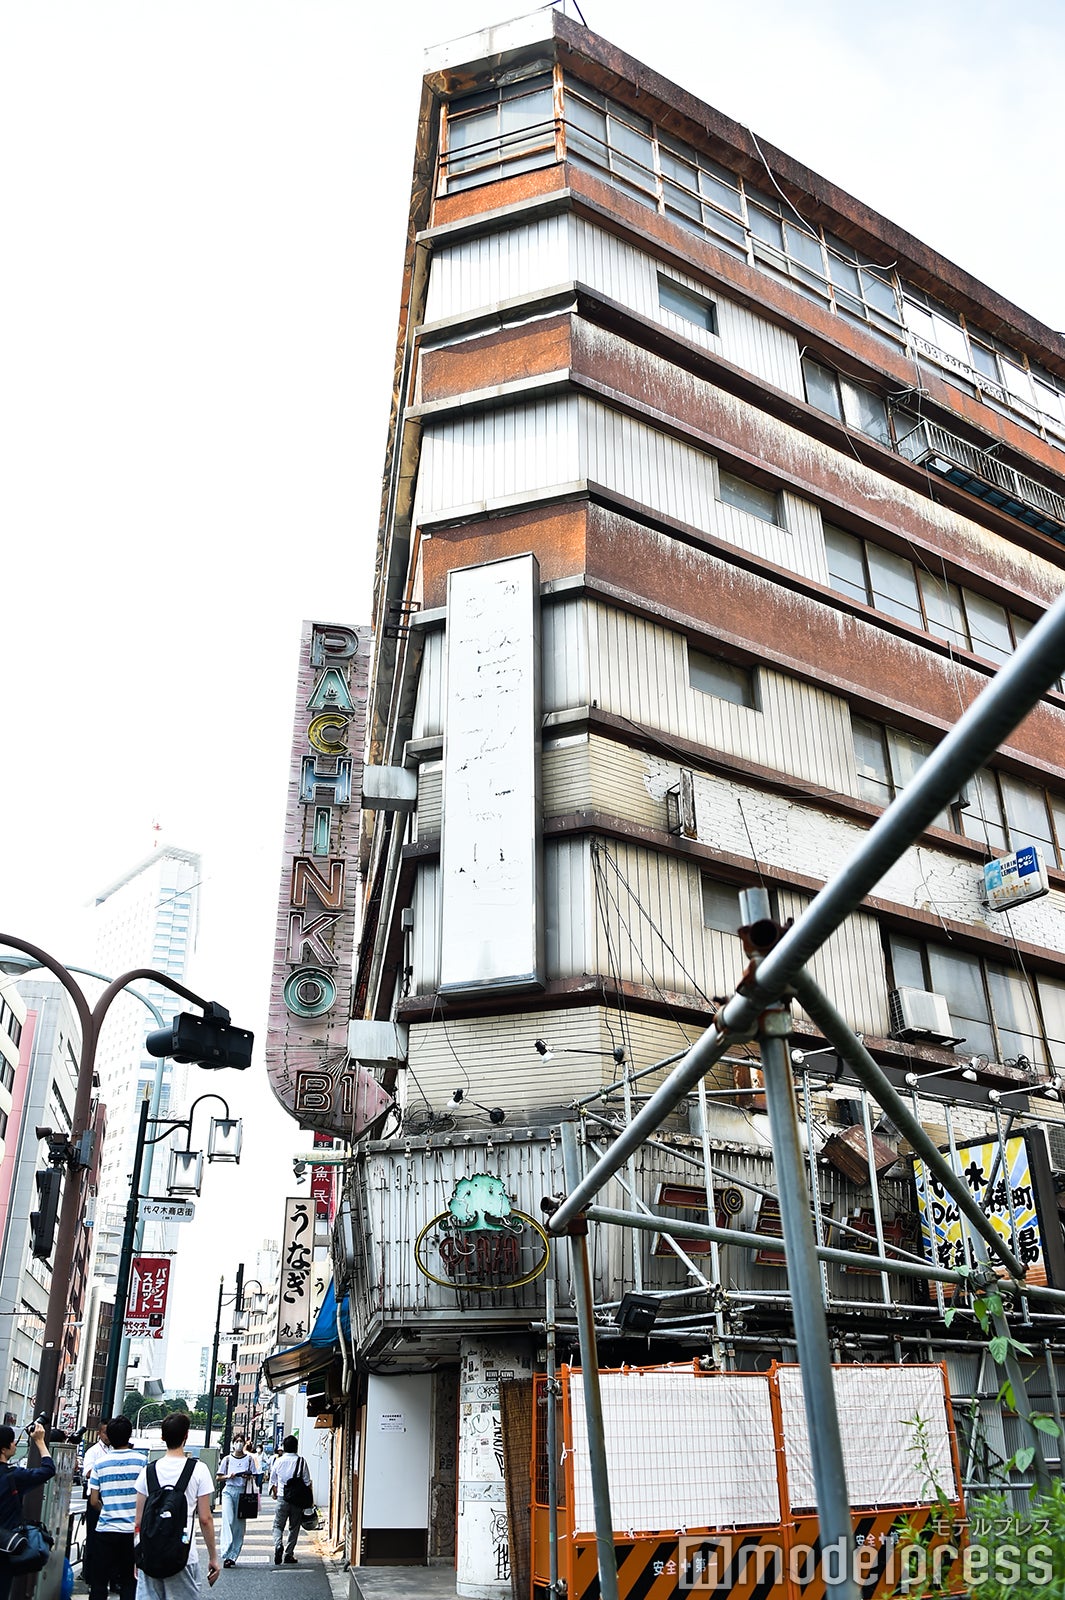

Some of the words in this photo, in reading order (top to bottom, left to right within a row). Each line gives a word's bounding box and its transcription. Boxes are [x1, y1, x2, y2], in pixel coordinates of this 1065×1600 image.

[284, 622, 360, 1018] PACHINKO
[1000, 860, 1017, 870] KIRIN
[294, 1070, 355, 1116] B1
[313, 1166, 330, 1205] 魚民
[143, 1205, 193, 1217] 代々木商店街
[283, 1203, 311, 1304] うなぎ
[142, 1272, 153, 1312] スロット
[153, 1267, 167, 1309] パチンコ
[125, 1321, 148, 1329] 代々木
[125, 1329, 152, 1337] アクアス
[280, 1320, 307, 1339] 丸善
